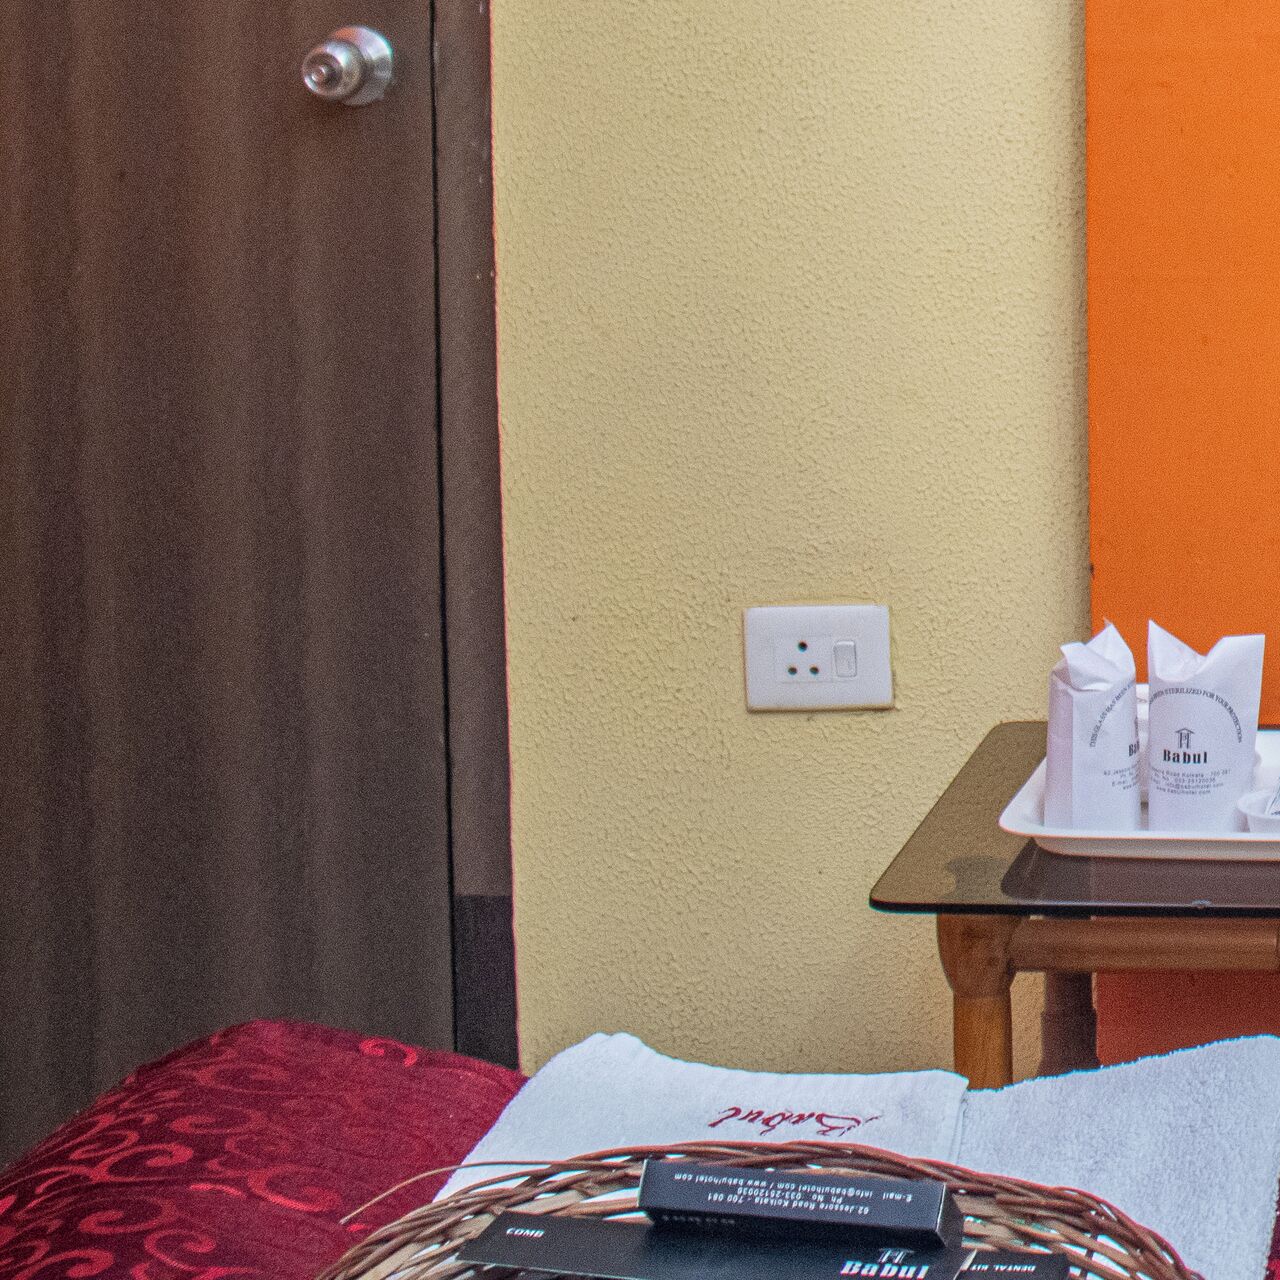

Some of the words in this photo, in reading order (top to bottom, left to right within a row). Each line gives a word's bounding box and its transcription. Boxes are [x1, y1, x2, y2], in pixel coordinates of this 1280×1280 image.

[1164, 687, 1202, 696] STERILIZED
[1202, 690, 1215, 699] FOR
[1215, 694, 1229, 710] YOUR
[1163, 749, 1207, 764] Babul
[708, 1106, 883, 1137] Babul
[707, 1193, 724, 1202] 081
[727, 1194, 744, 1204] 700
[754, 1197, 788, 1207] Kolkata
[882, 1192, 913, 1203] E-mail
[792, 1200, 815, 1210] Road
[506, 1227, 545, 1238] COMB
[840, 1261, 930, 1280] Babul
[970, 1263, 989, 1272] KIT
[993, 1263, 1036, 1273] DENTAL
